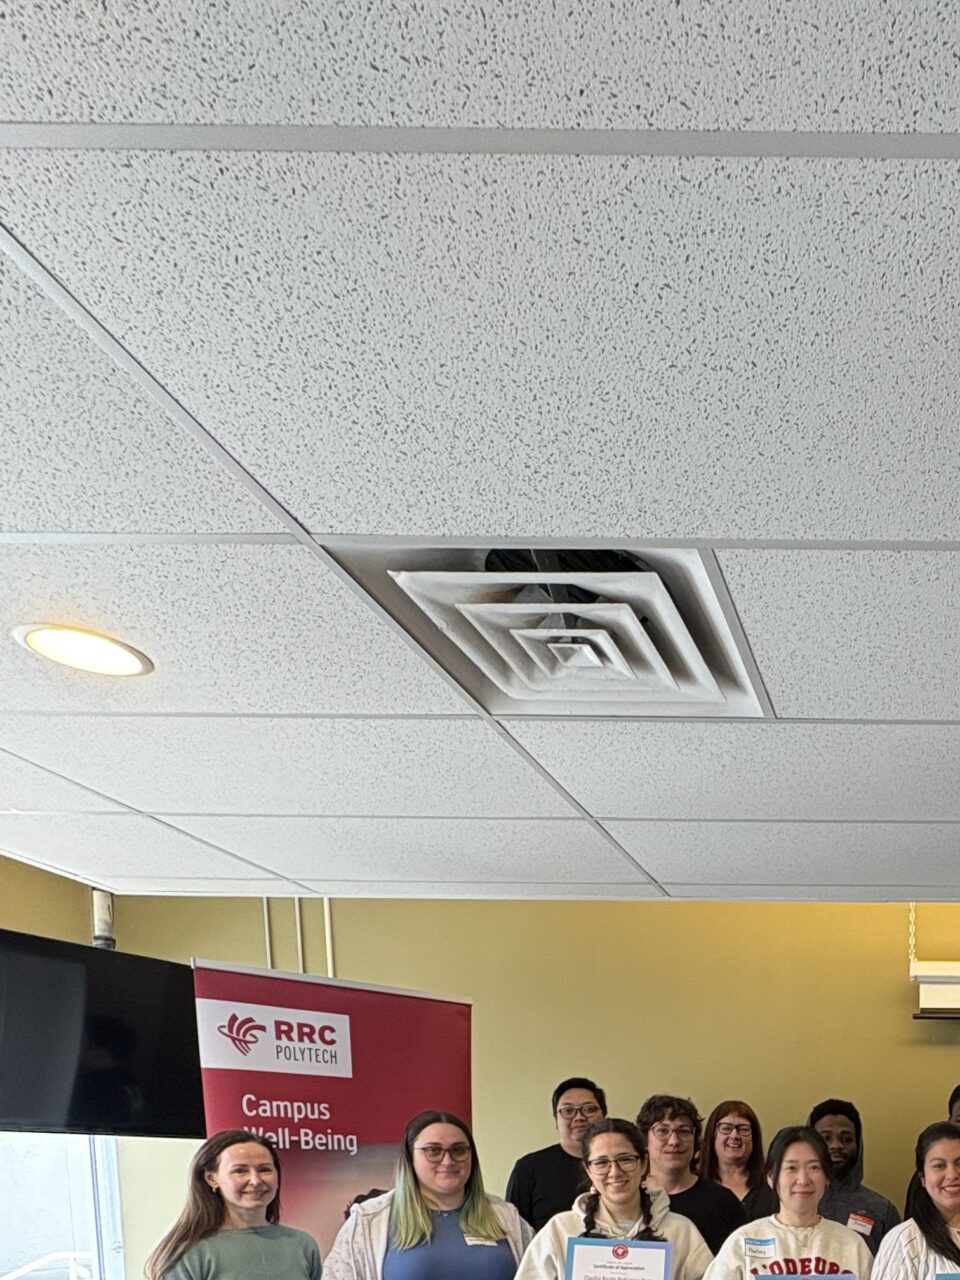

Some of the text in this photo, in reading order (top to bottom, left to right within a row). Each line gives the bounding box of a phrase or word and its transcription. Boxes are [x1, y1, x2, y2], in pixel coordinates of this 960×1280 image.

[274, 1020, 337, 1045] RRC
[276, 1045, 337, 1064] POLYTECH
[242, 1094, 330, 1123] Campus
